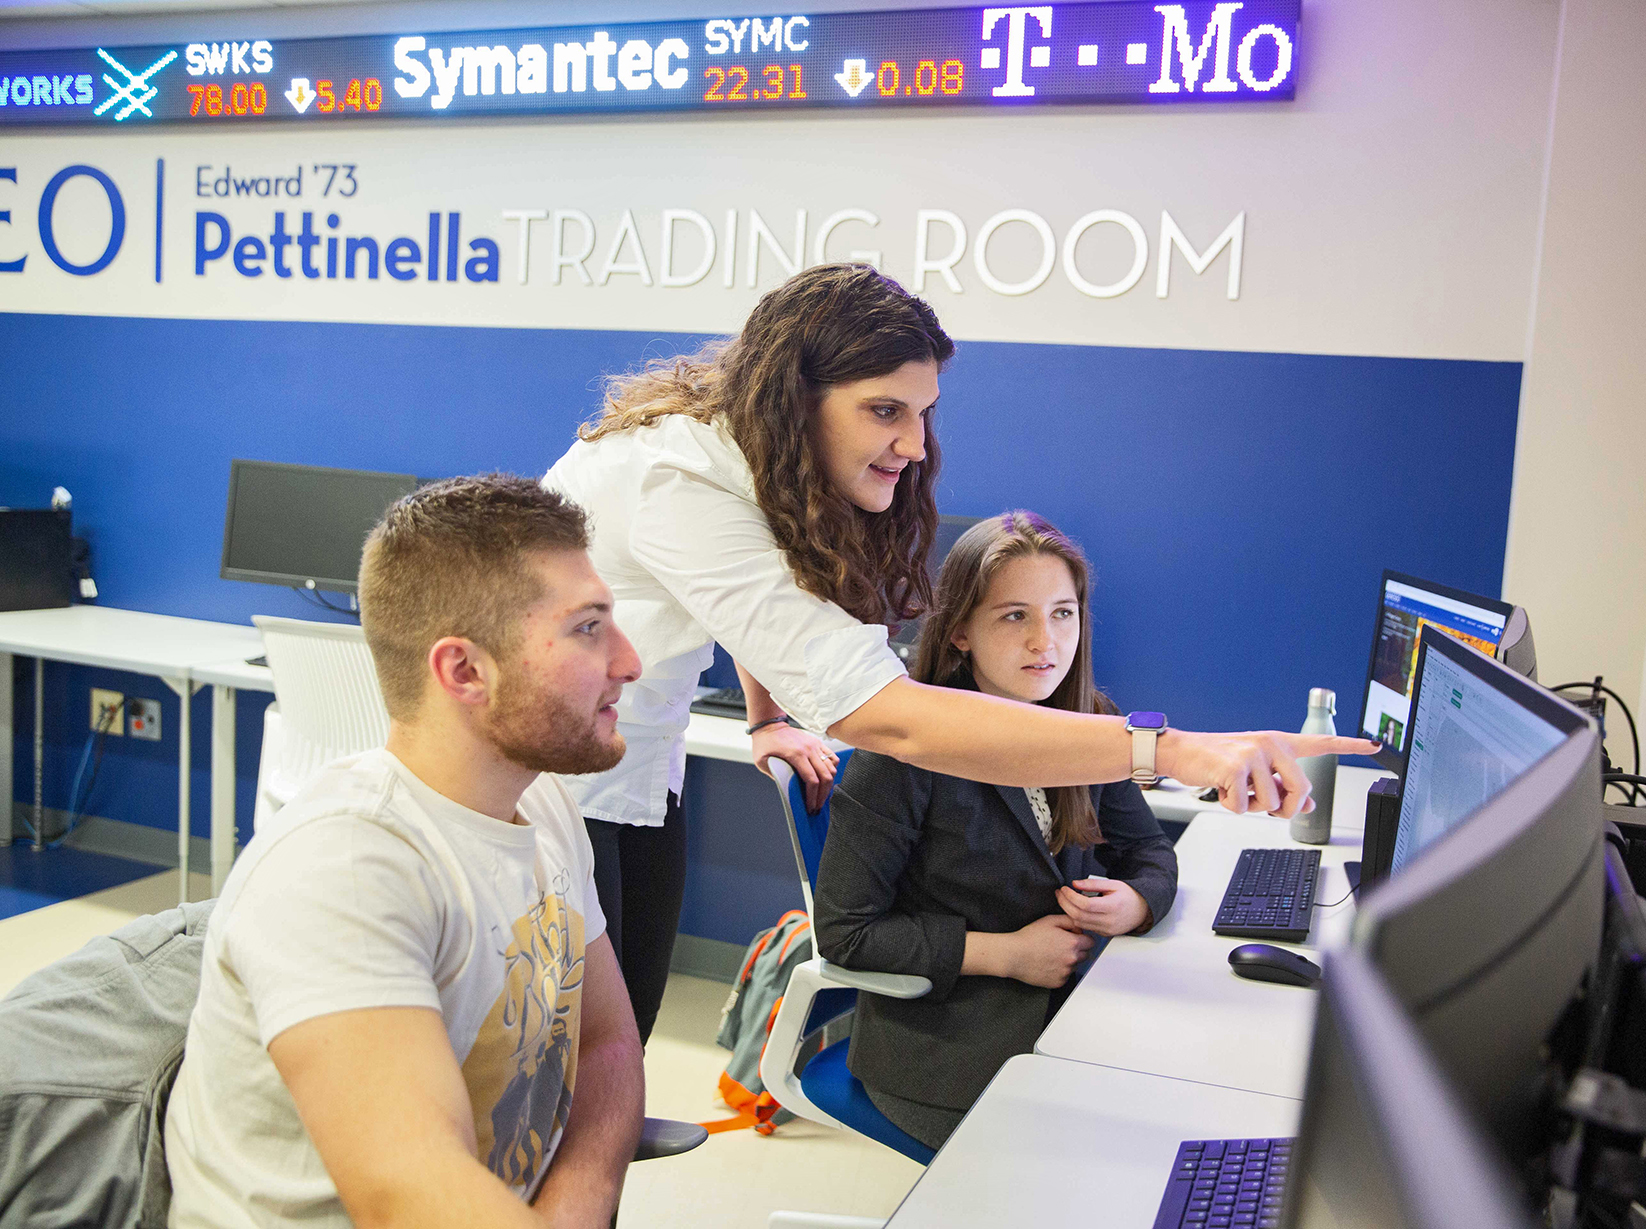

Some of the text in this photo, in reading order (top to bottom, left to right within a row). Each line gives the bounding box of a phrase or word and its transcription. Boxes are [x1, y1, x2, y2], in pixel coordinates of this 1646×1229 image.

[705, 16, 810, 54] SYMC
[185, 40, 273, 76] SWKS
[394, 31, 689, 109] Symantec
[187, 78, 383, 116] 78.00 5.40
[704, 59, 964, 102] 22.31 0.08
[196, 165, 358, 197] Edward '73
[195, 208, 1246, 301] Pettinella TRADING ROOM
